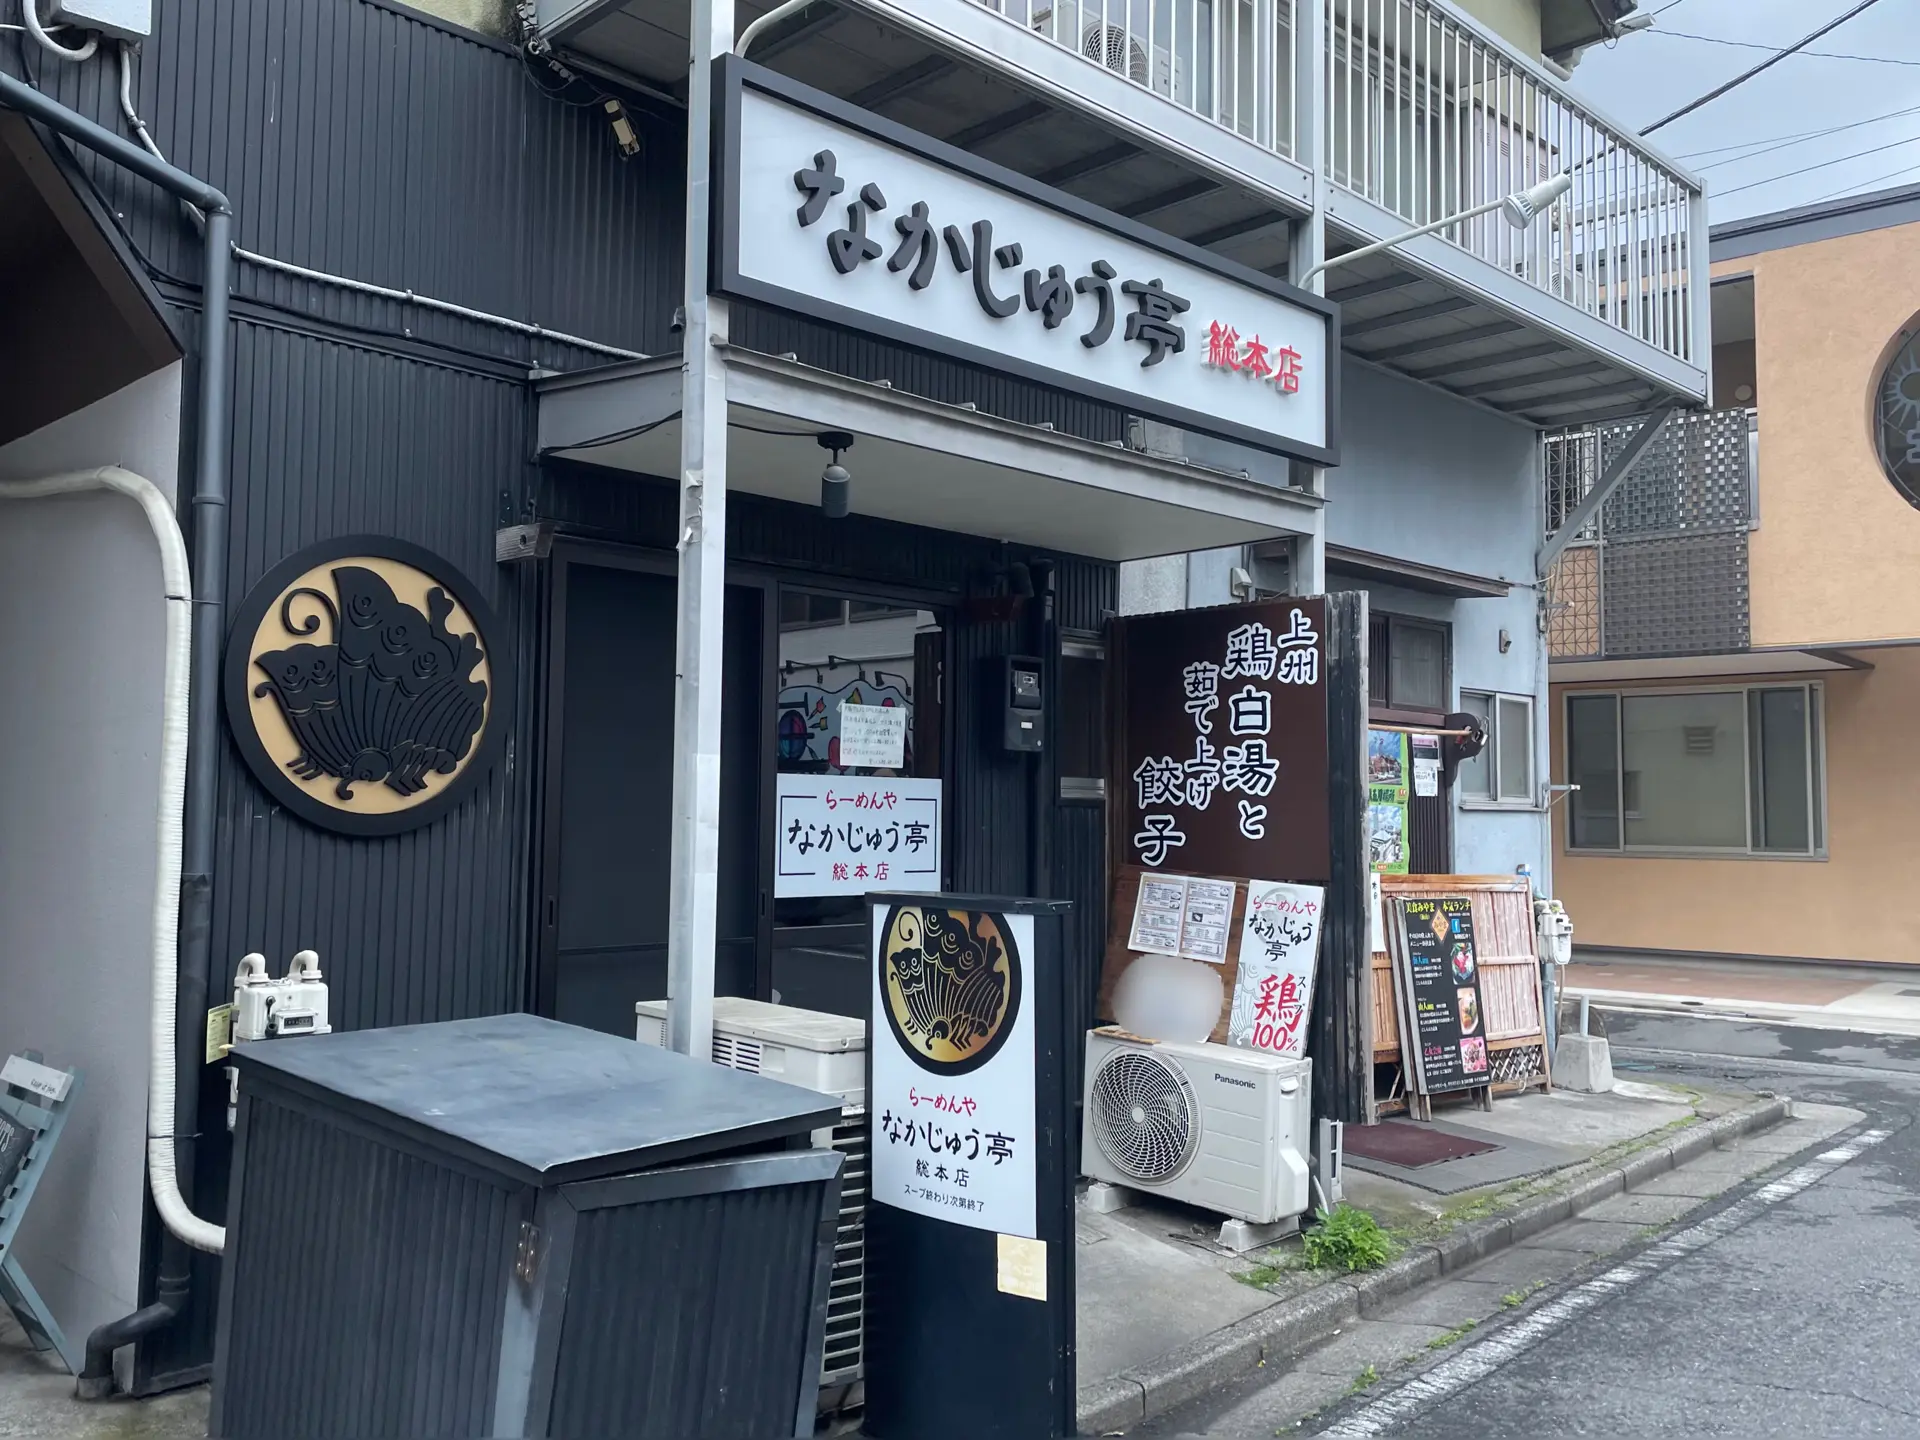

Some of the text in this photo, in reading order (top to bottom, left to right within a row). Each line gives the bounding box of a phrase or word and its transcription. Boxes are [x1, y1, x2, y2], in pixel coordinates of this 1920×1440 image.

[793, 149, 1304, 394] なかじゅう亭 総本店
[1277, 608, 1319, 685] 上州
[1183, 661, 1221, 811] 茹で上げ
[1221, 622, 1280, 840] 鶏白湯と
[825, 789, 898, 811] らーめんや
[1133, 756, 1187, 867] 餃子
[788, 818, 930, 855] なかじゅう亭
[832, 862, 890, 881] 総本店
[1253, 895, 1317, 916] らーめんや
[1248, 913, 1313, 946] なかじゅう
[1264, 940, 1290, 962] 亭
[1253, 972, 1304, 1033] 鶏
[1251, 1021, 1299, 1052] 100%
[1214, 1073, 1256, 1090] Panasonic
[909, 1087, 977, 1117] らーめんや
[882, 1109, 1015, 1165] なかじゅう亭
[915, 1158, 969, 1187] 総本店
